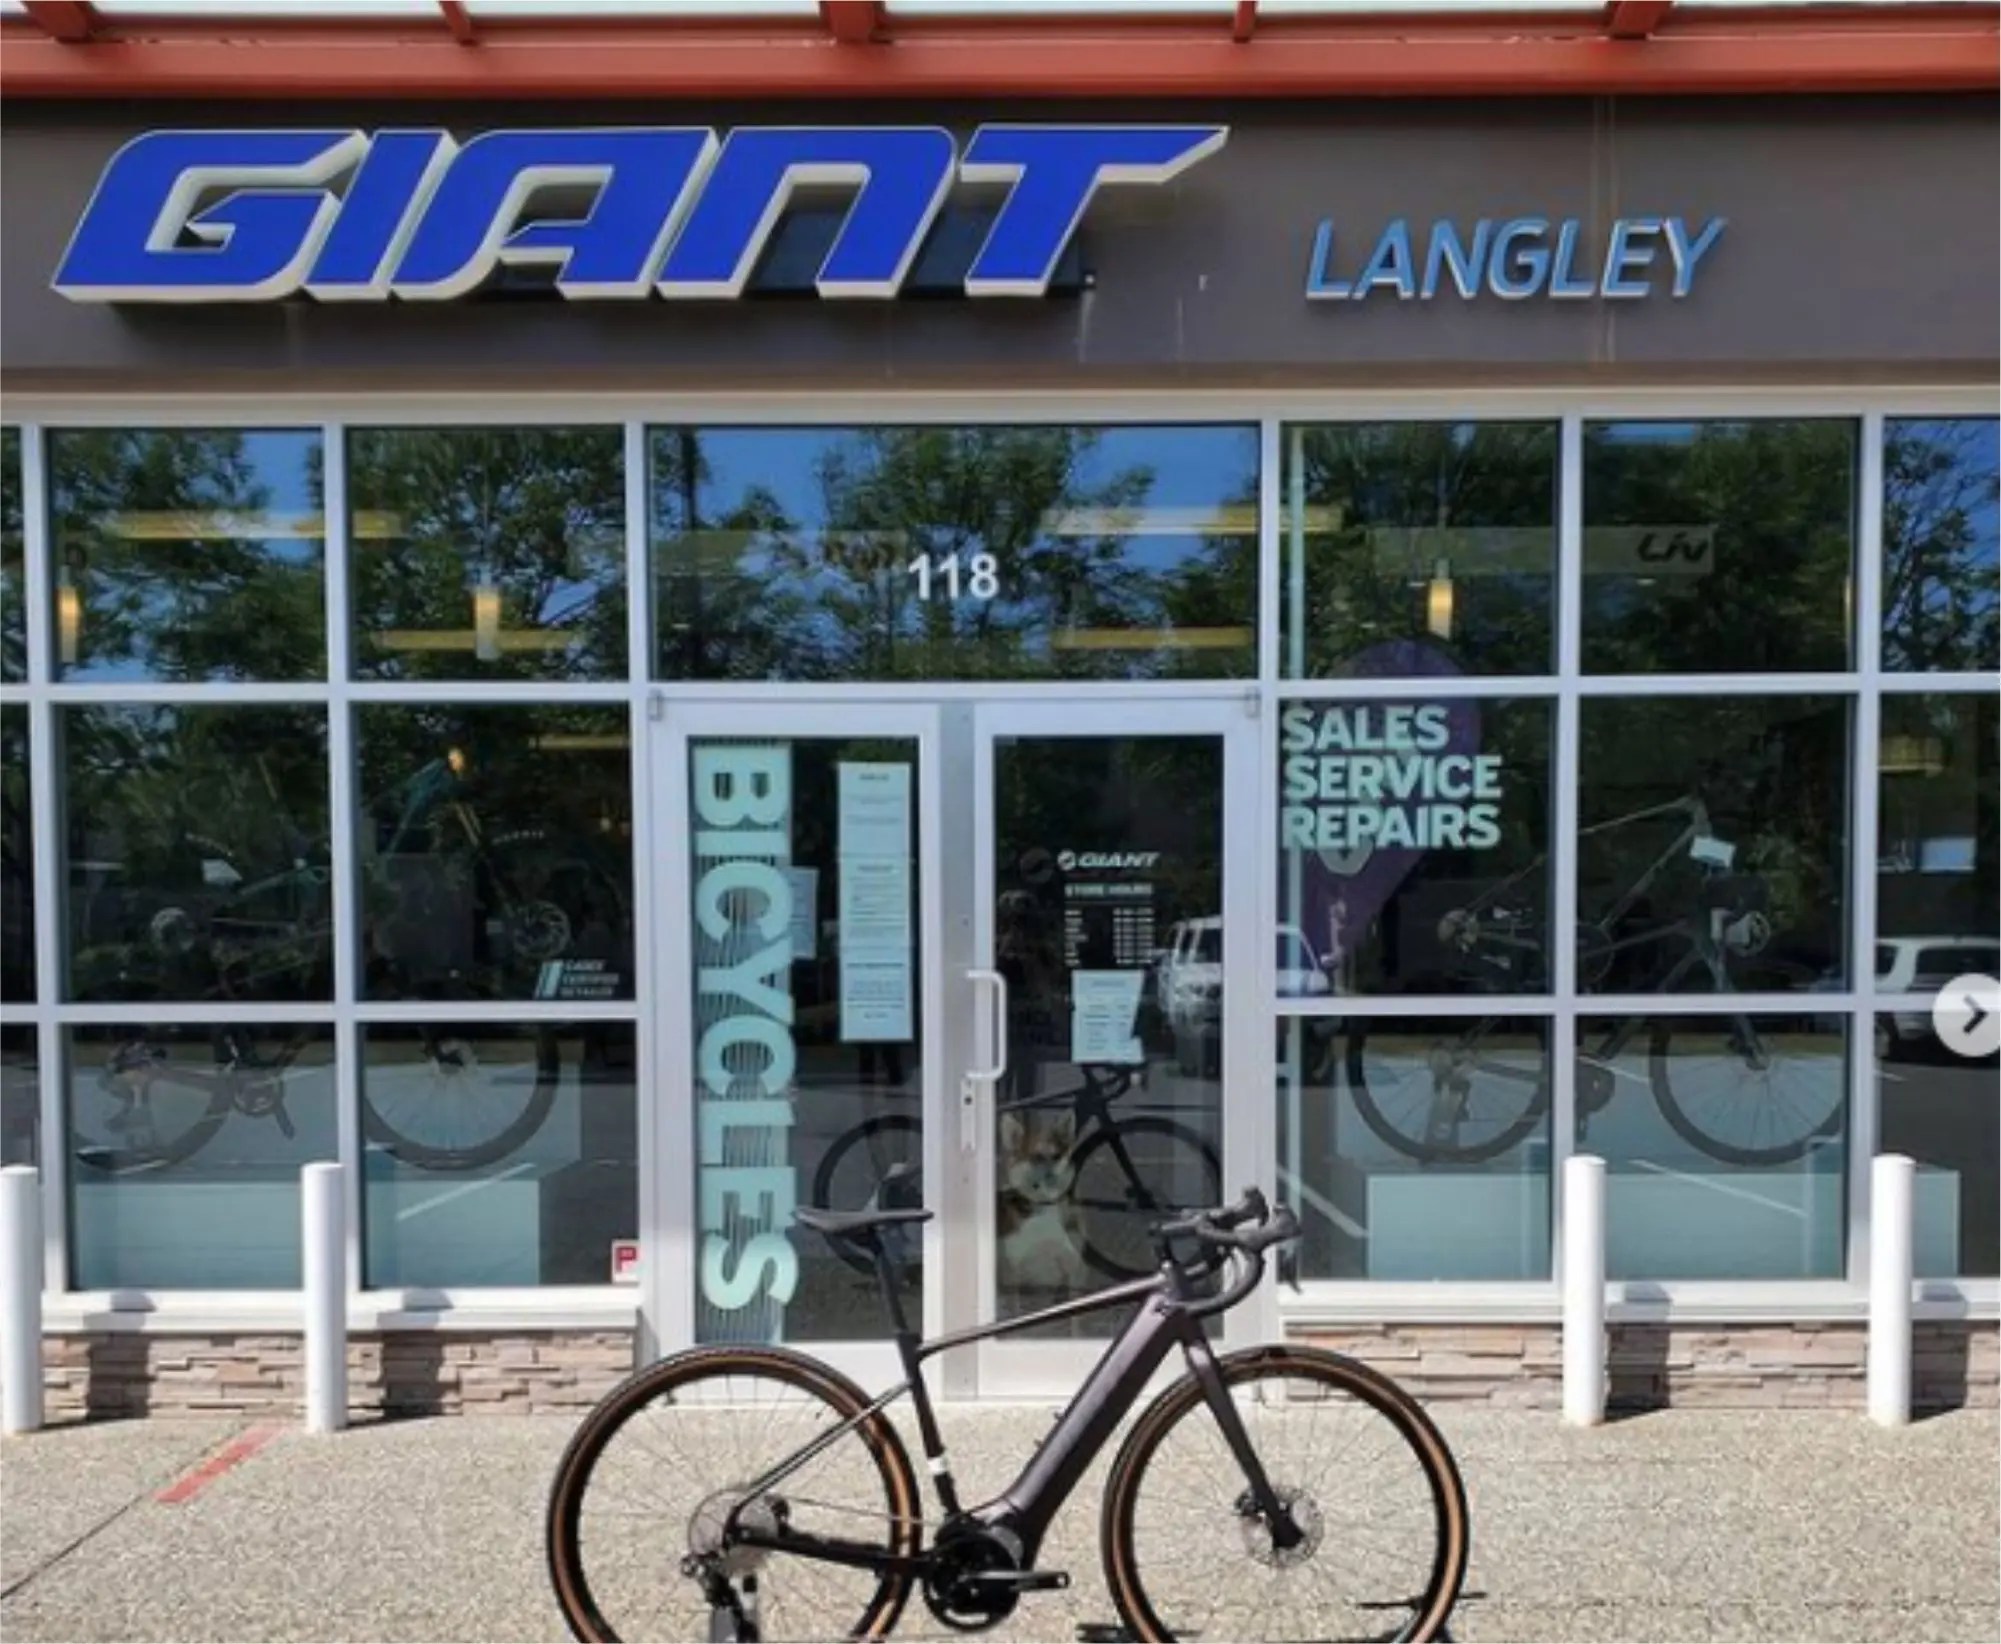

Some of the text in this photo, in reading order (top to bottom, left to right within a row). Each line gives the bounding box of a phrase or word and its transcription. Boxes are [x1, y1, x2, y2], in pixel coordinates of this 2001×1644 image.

[50, 124, 1230, 302] GIANT
[1305, 216, 1728, 300] LANGLEY
[908, 552, 998, 600] 118
[1282, 705, 1449, 750] SALES
[1284, 754, 1502, 799] SERVICE
[1282, 804, 1501, 848] REPAIRS
[694, 746, 799, 1311] BICYCLES
